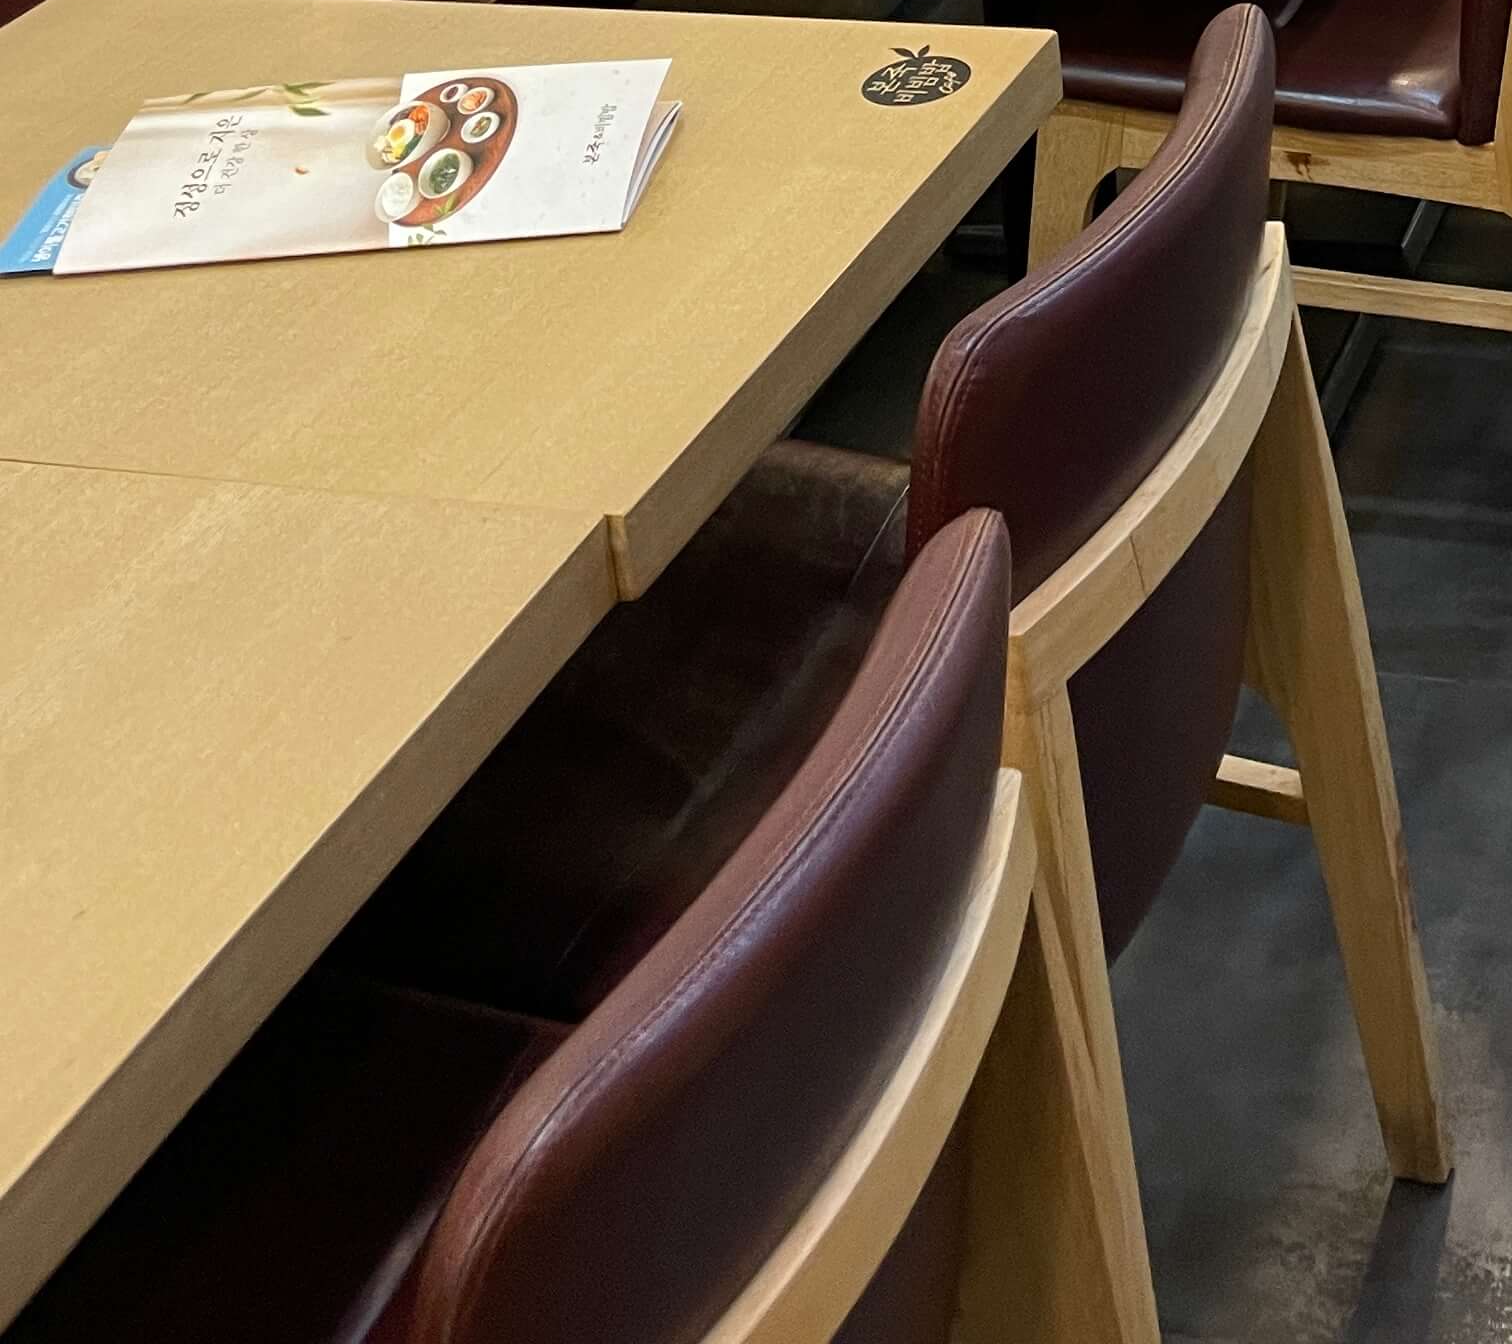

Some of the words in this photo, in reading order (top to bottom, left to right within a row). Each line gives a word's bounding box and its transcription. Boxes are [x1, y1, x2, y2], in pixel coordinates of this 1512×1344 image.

[867, 62, 917, 95] 본죽
[893, 59, 953, 102] 비빔밥
[173, 148, 222, 217] 정성으로
[208, 115, 243, 144] 지은
